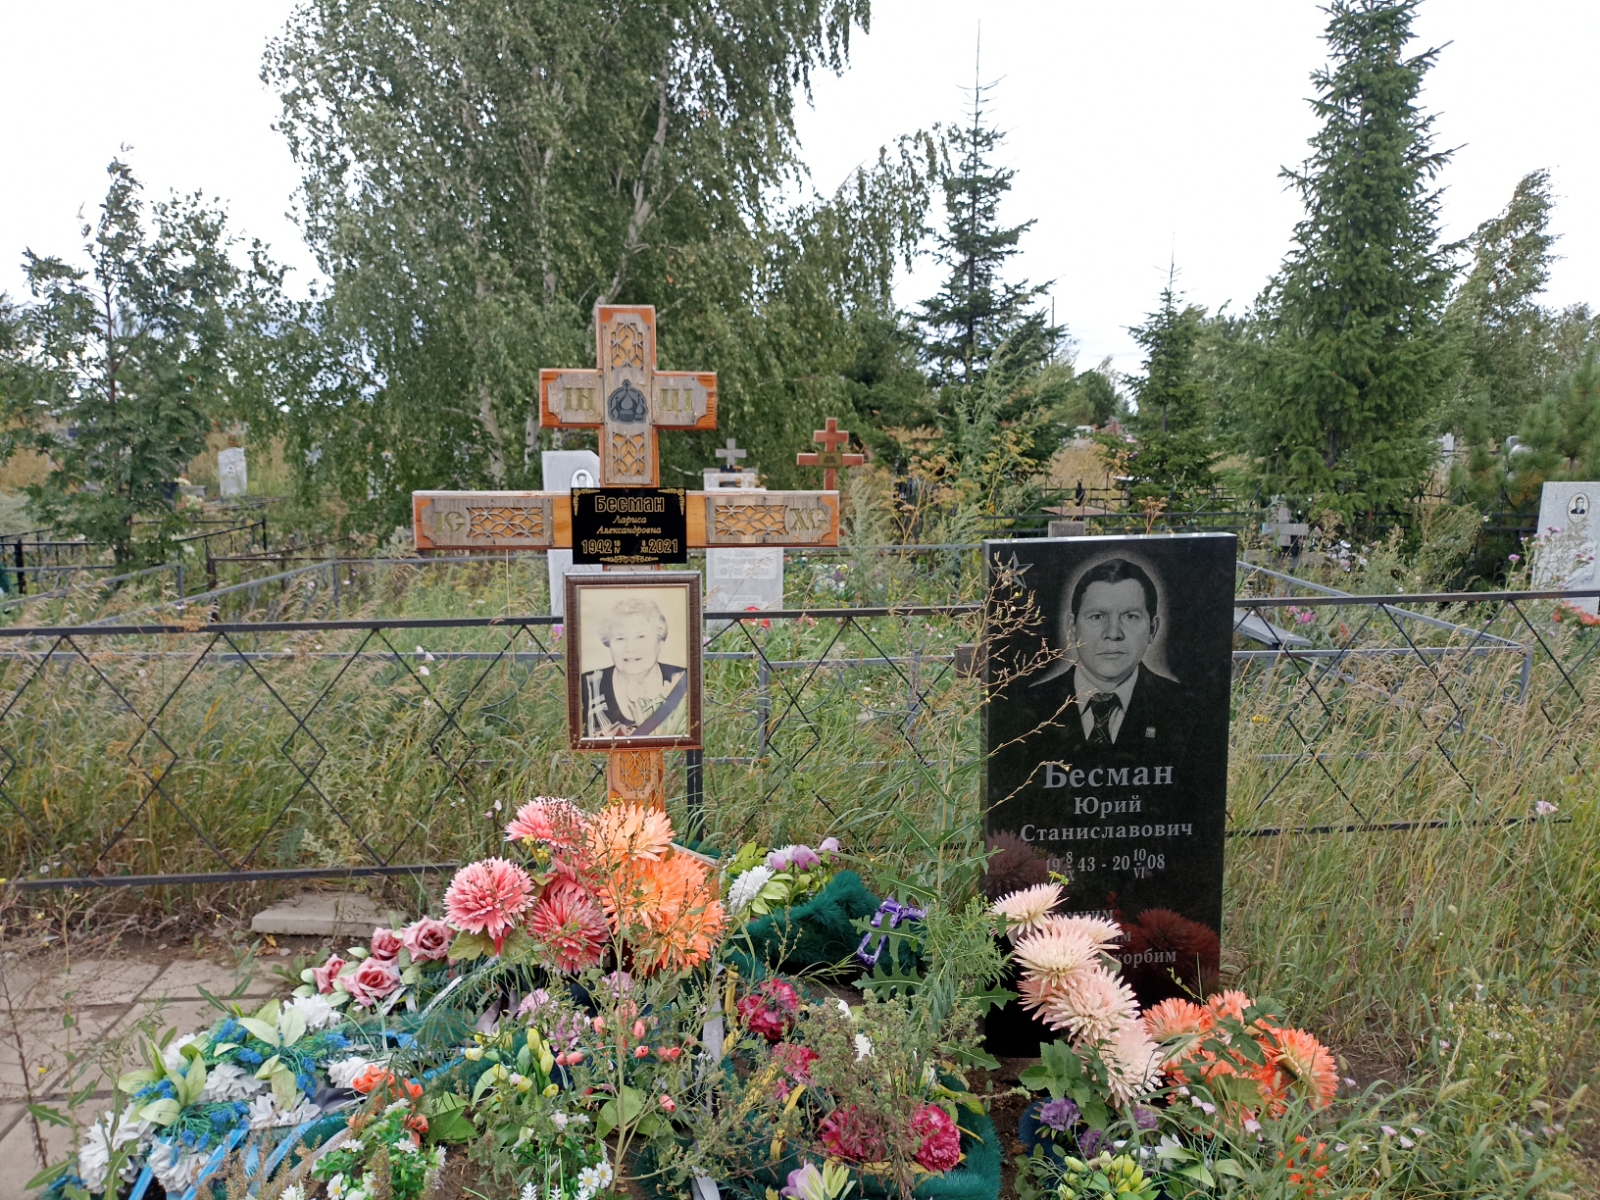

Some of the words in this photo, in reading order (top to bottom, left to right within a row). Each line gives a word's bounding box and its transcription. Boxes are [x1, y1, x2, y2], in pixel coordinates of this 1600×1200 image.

[594, 495, 665, 513] Бесман
[612, 515, 647, 526] Лариса
[596, 525, 662, 537] Александровна
[581, 539, 613, 554] 1942
[648, 538, 678, 554] 2021
[1043, 762, 1174, 788] Бесман
[1073, 794, 1142, 818] Юрий
[1020, 822, 1193, 842] Станиславович
[1077, 856, 1096, 872] 43
[1112, 855, 1131, 871] 20
[1147, 853, 1166, 870] 08
